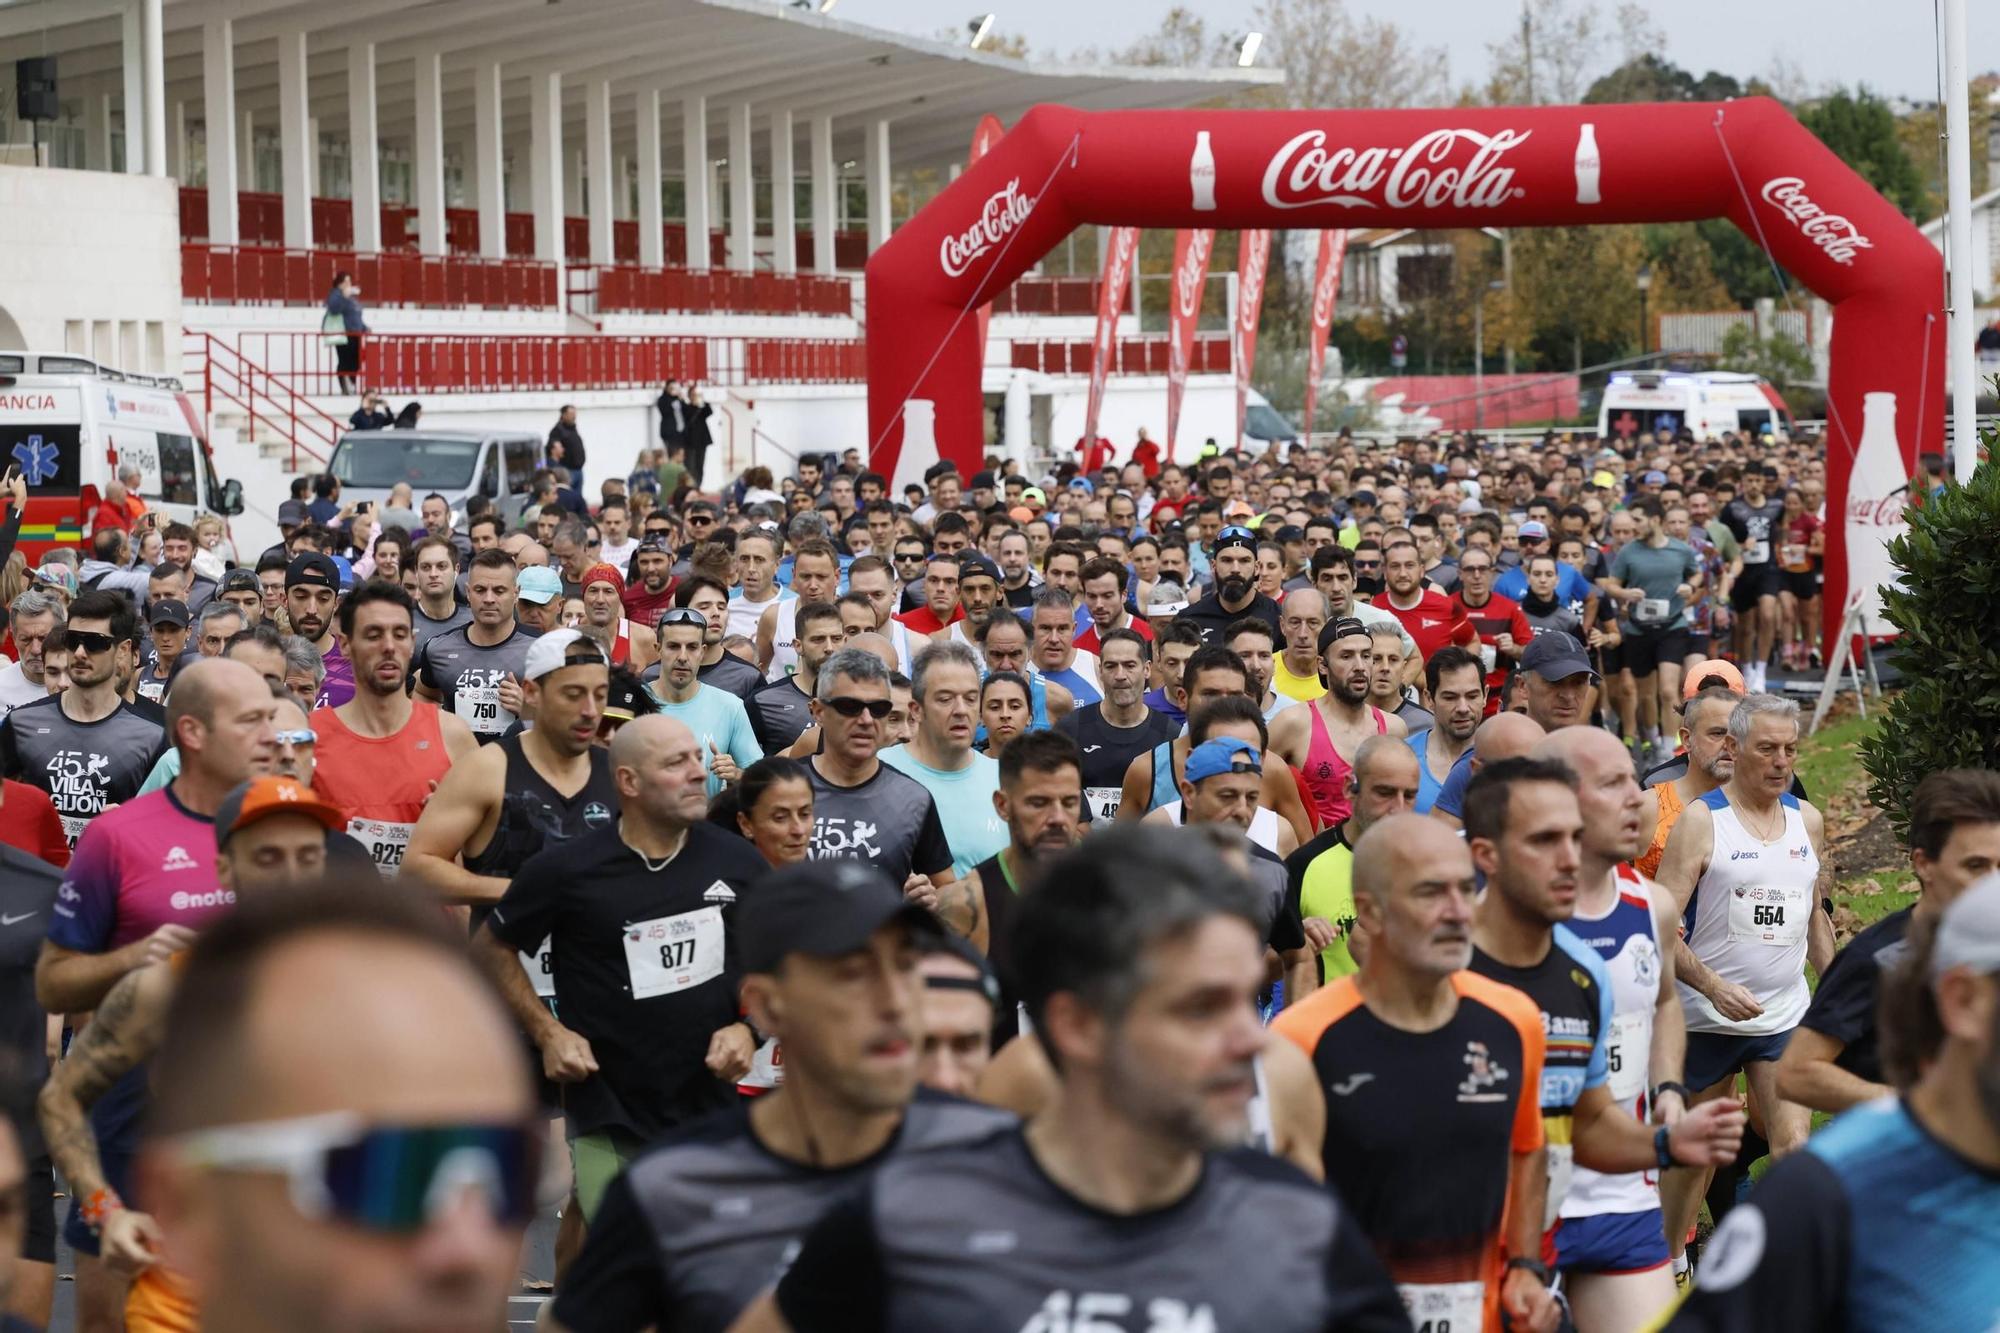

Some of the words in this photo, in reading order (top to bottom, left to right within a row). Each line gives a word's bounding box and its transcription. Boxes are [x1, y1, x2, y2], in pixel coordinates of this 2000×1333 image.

[1261, 128, 1533, 209] Coca-Cola
[940, 176, 1030, 278] Coca-Cola
[1761, 176, 1875, 264] Coca-Cola
[456, 668, 486, 688] 45
[473, 703, 497, 719] 750
[46, 749, 84, 778] 45
[49, 775, 96, 796] VILLA
[50, 791, 107, 813] GIJÓN
[368, 824, 385, 838] 45
[372, 842, 406, 865] 925
[1740, 851, 1759, 859] asics
[1749, 888, 1765, 901] 45
[1753, 904, 1785, 927] 554
[648, 924, 666, 939] 45
[660, 938, 696, 969] 877
